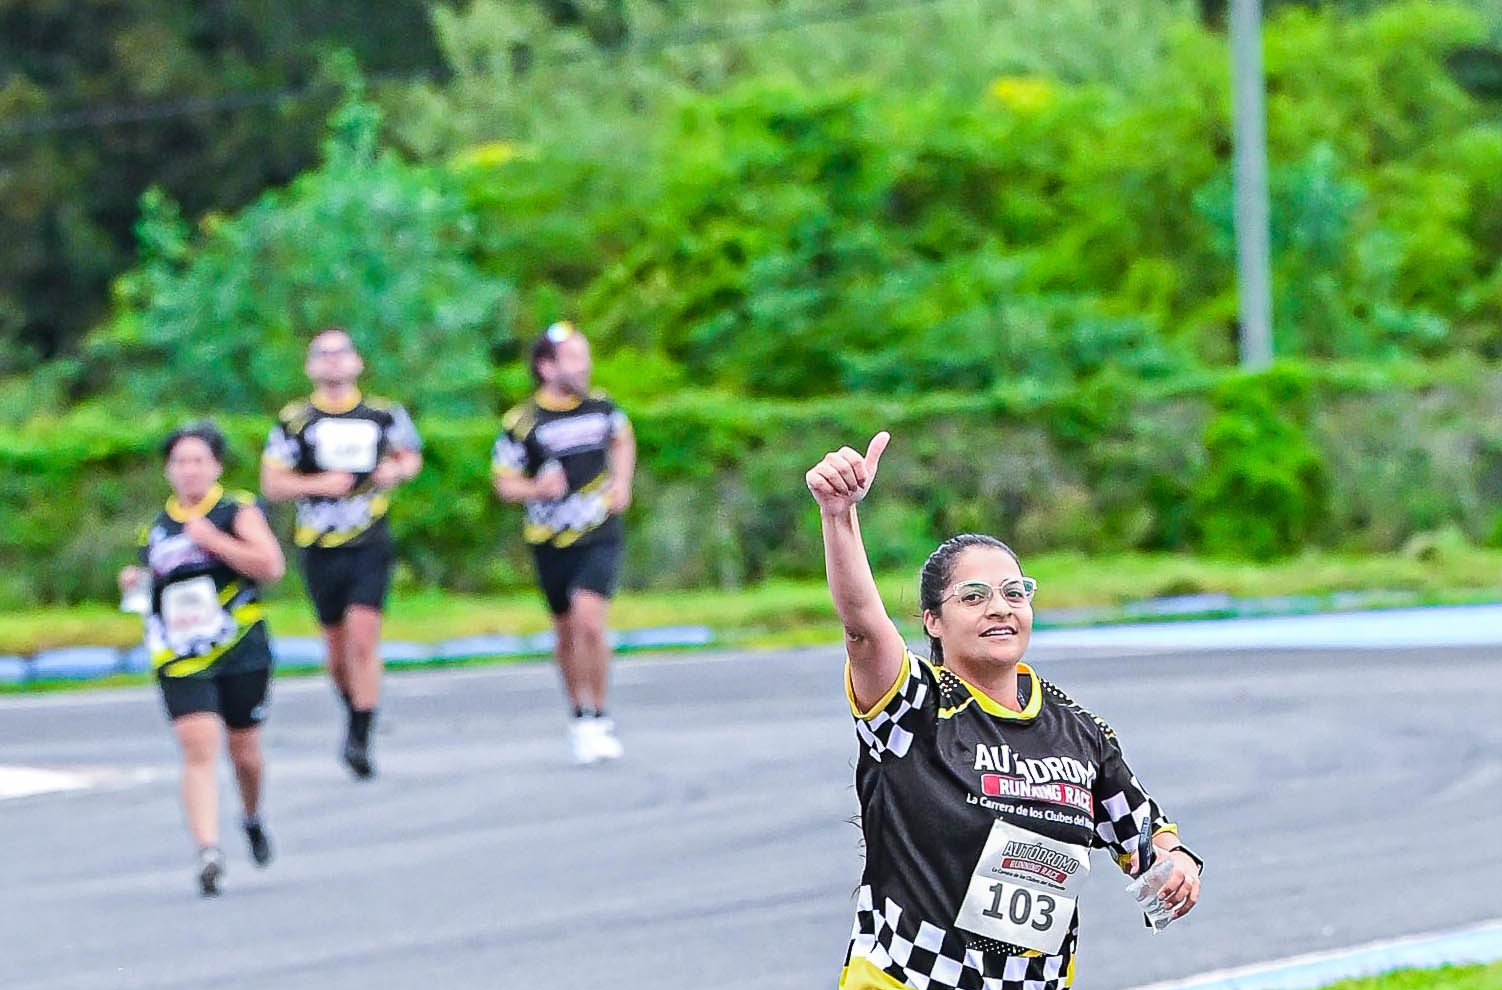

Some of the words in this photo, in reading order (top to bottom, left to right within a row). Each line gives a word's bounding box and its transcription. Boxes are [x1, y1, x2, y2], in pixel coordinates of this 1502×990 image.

[966, 793, 978, 805] La
[979, 796, 1015, 813] Carrera
[1015, 804, 1029, 817] de
[1029, 806, 1044, 819] los
[1044, 810, 1073, 825] Clubes
[1002, 840, 1080, 874] AUTÓDROMO
[982, 882, 1056, 931] 103
